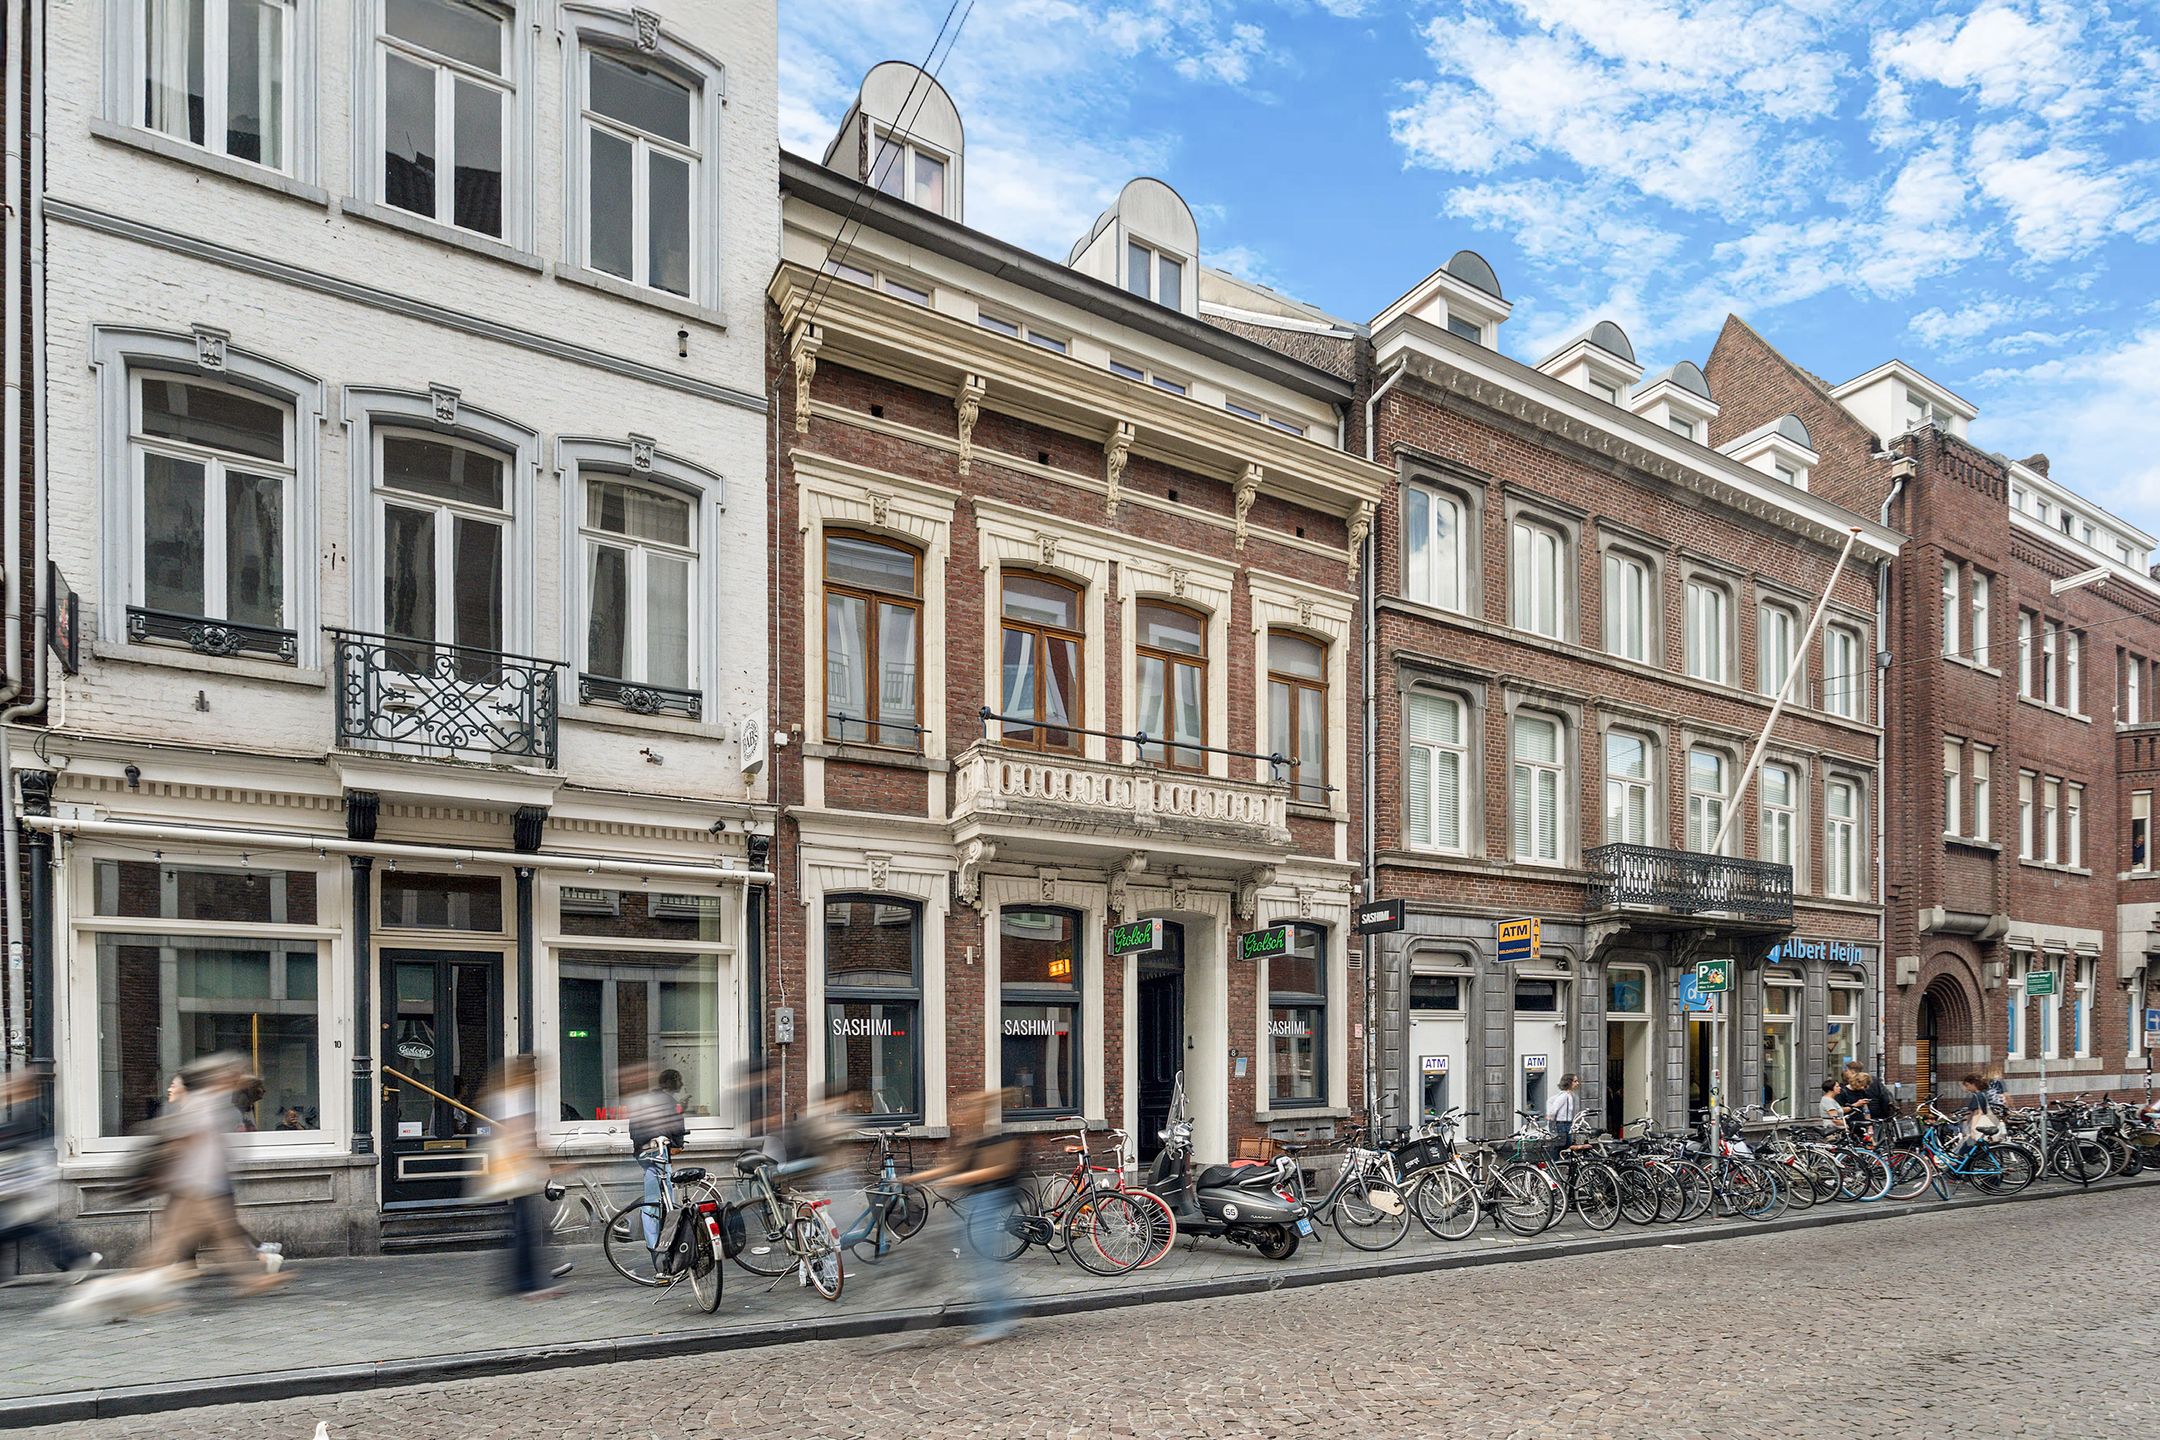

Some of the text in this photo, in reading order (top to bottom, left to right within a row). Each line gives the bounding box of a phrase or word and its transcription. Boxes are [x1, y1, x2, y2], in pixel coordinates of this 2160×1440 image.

[1114, 922, 1152, 953] Grolsch
[1502, 925, 1528, 938] ATM
[1244, 929, 1285, 958] Grolsch
[1782, 936, 1827, 960] Albert
[1829, 942, 1862, 967] Heijn
[334, 1040, 342, 1049] 10
[1425, 1058, 1446, 1068] ATM
[1527, 1057, 1545, 1067] ATM
